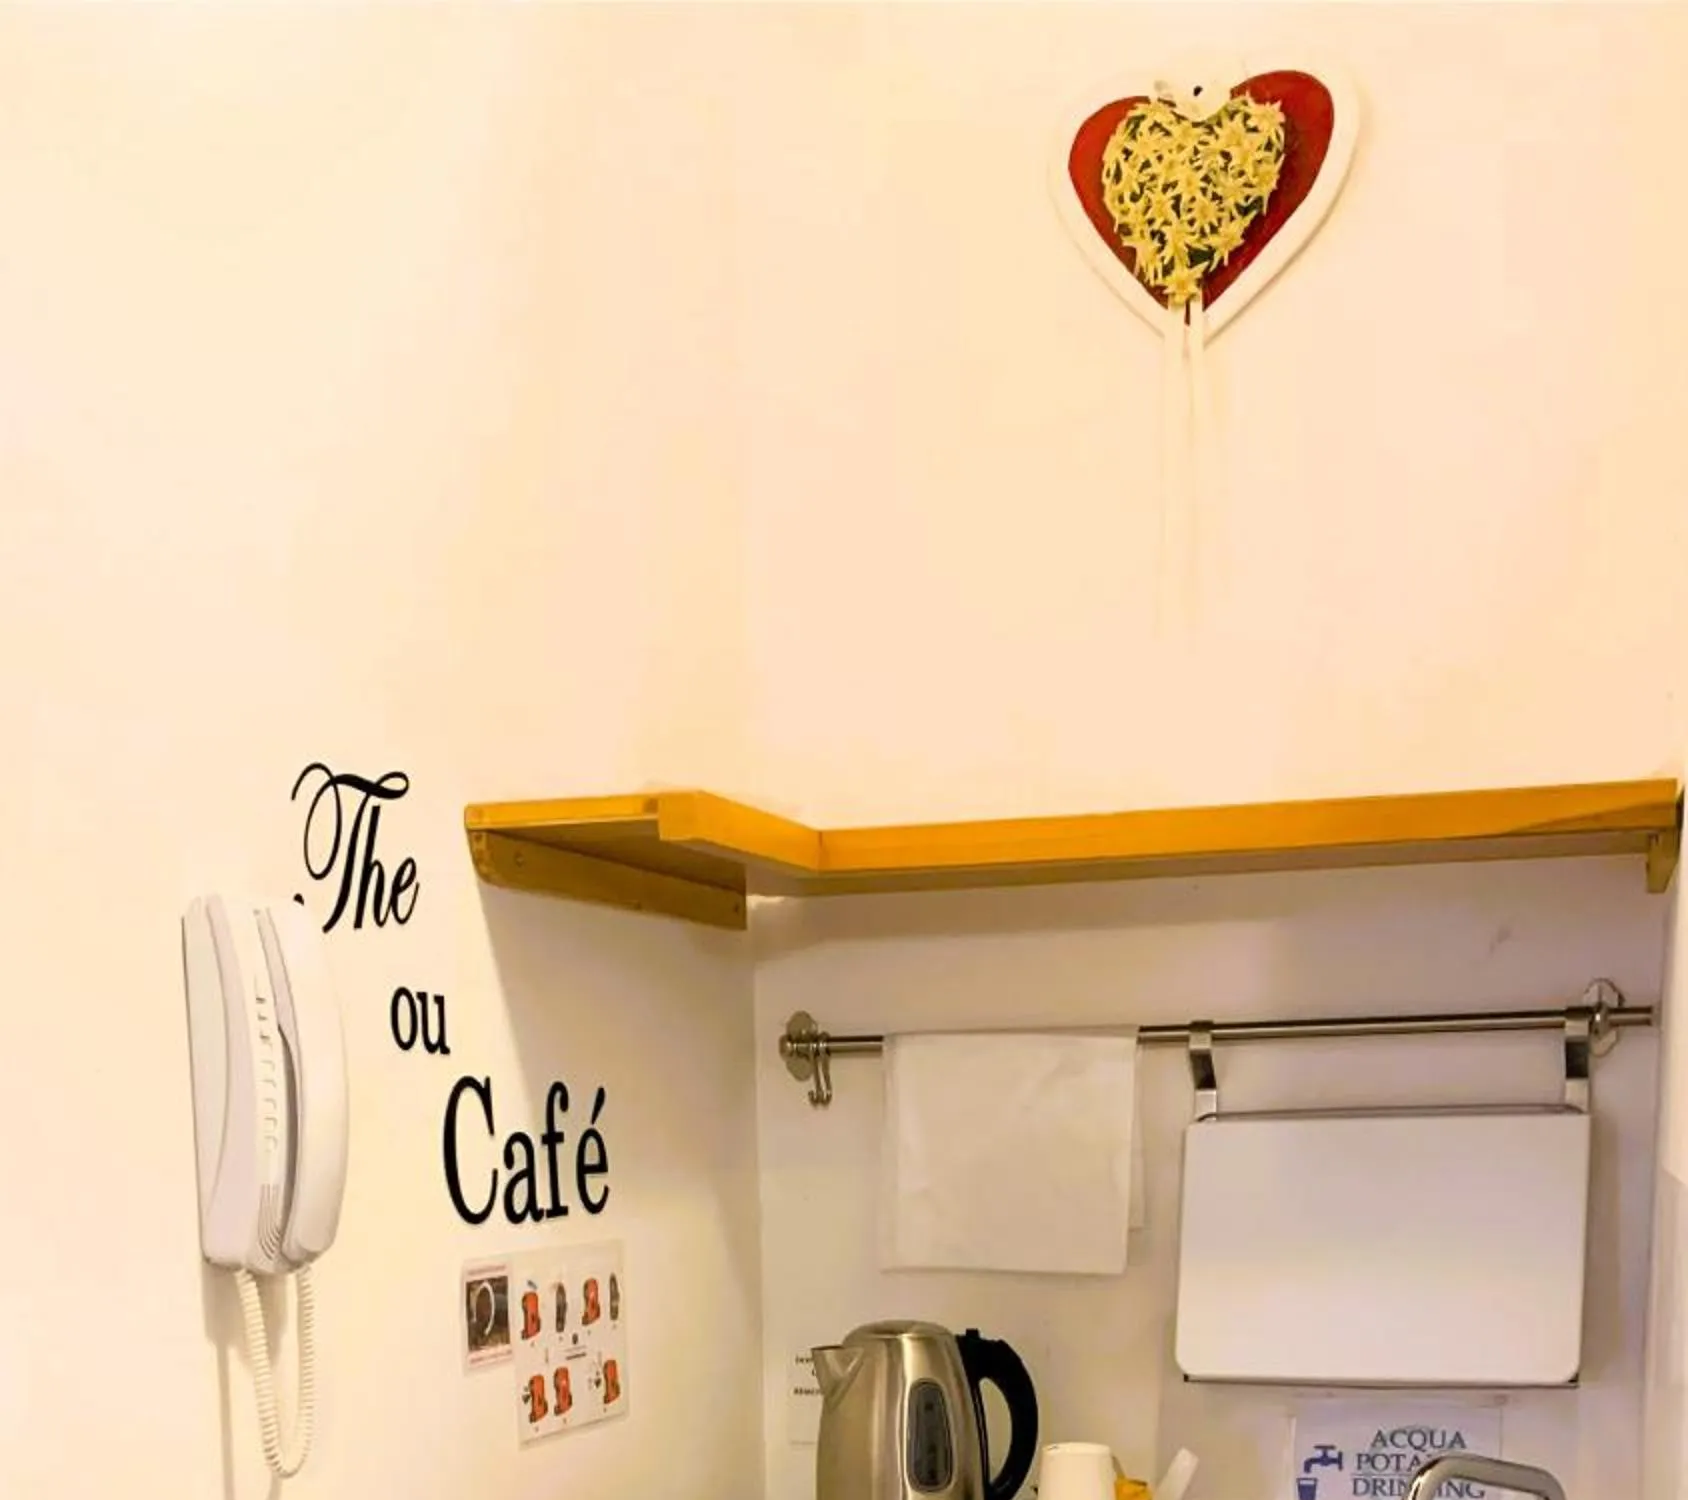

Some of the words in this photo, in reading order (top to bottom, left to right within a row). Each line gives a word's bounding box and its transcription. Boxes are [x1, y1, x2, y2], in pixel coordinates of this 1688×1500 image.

[291, 762, 420, 934] The
[390, 986, 451, 1055] ou
[443, 1075, 610, 1225] Café
[1356, 1452, 1433, 1473] POTA
[1370, 1429, 1468, 1452] ACQUA
[1352, 1477, 1486, 1499] DRINING
